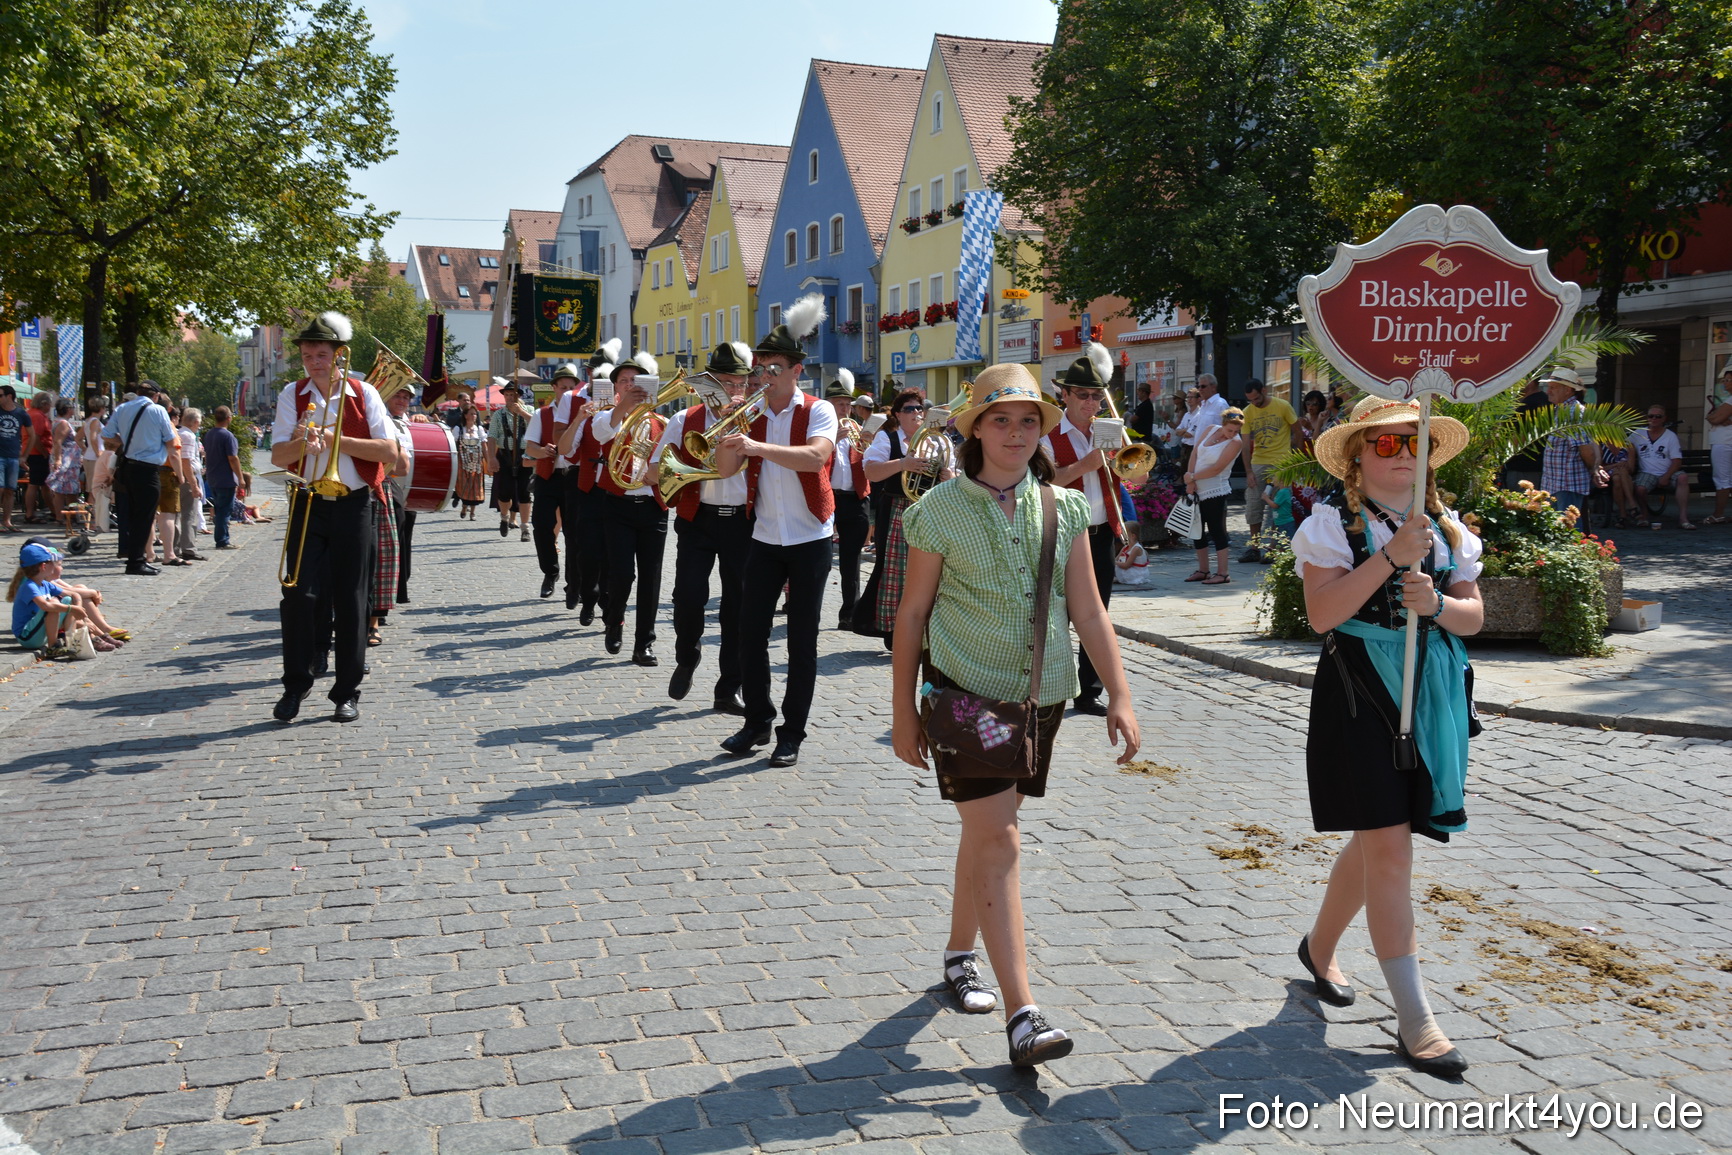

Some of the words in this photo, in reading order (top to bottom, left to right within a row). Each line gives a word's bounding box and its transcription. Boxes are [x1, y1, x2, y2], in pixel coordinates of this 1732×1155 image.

[1005, 290, 1018, 298] KINO
[1359, 280, 1527, 314] Blaskapelle
[660, 302, 674, 317] HOTEL
[865, 315, 875, 358] WITTL
[1371, 315, 1513, 343] Dirnhofer
[894, 354, 903, 371] P
[1418, 349, 1456, 368] Stauf
